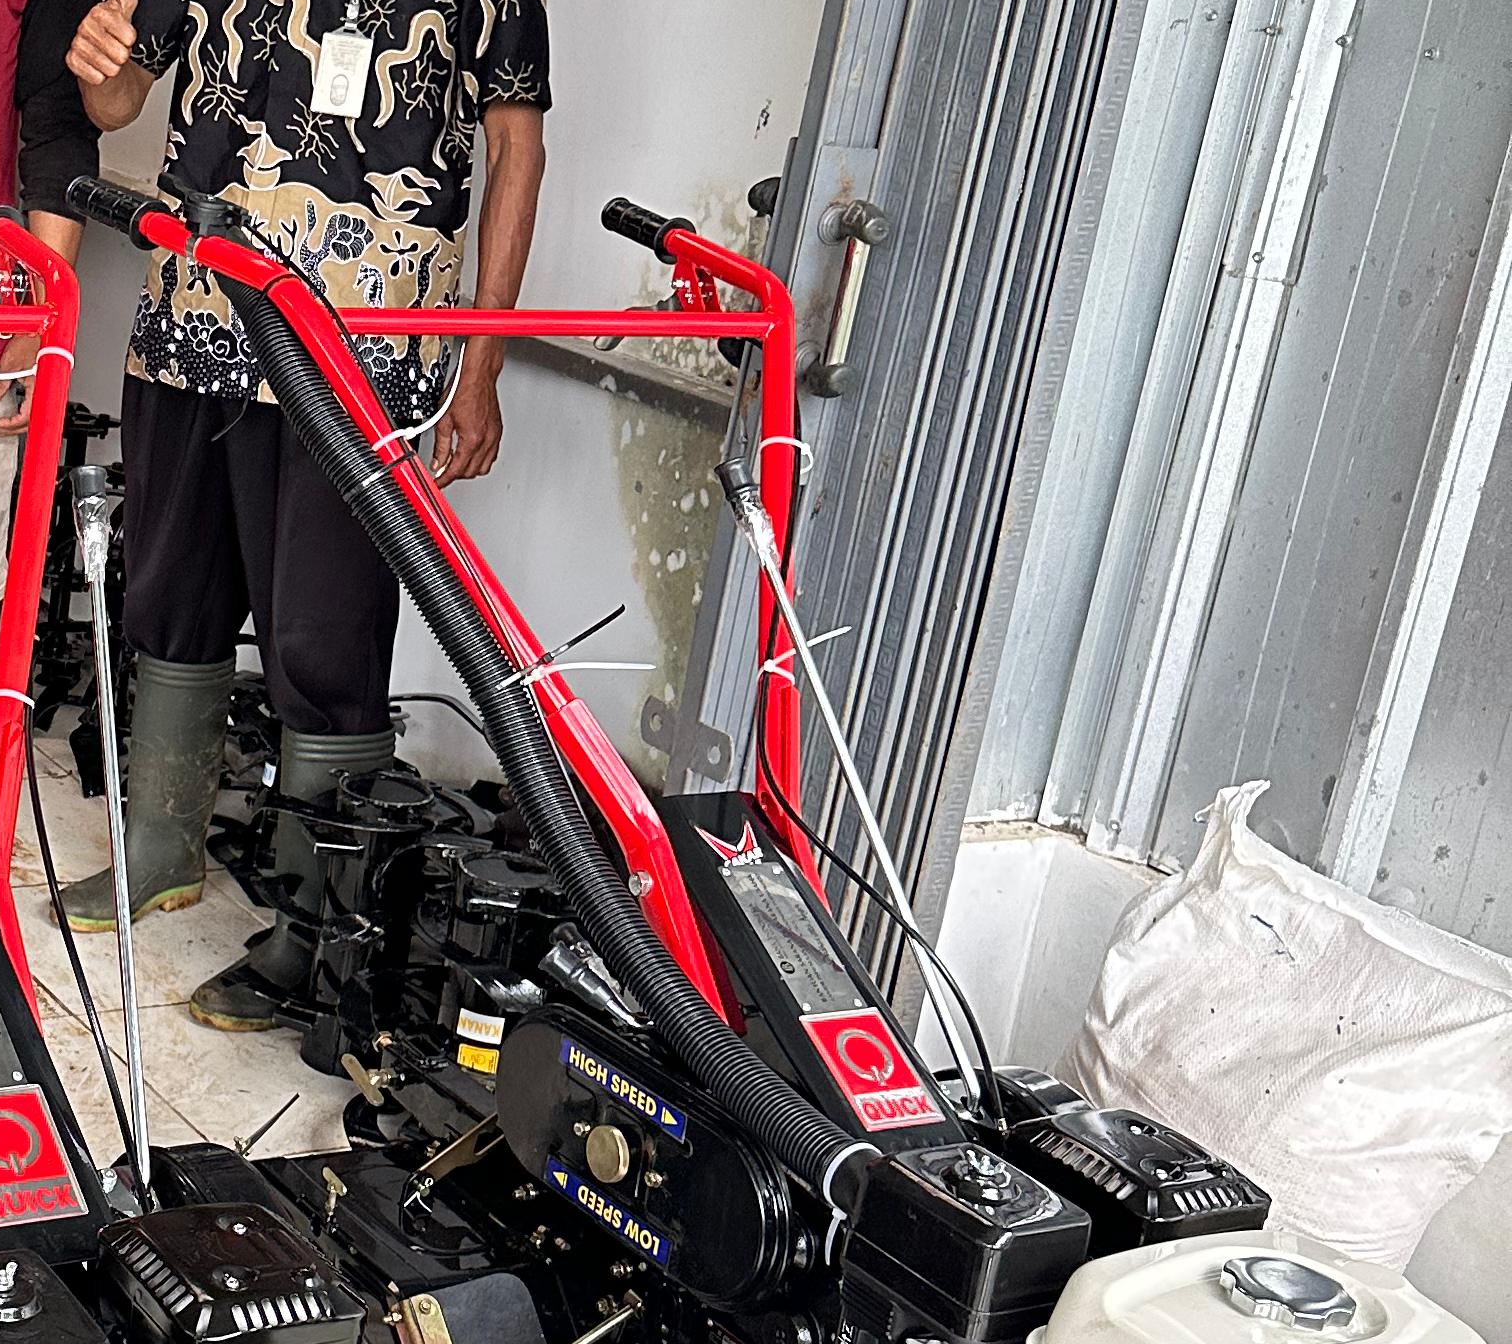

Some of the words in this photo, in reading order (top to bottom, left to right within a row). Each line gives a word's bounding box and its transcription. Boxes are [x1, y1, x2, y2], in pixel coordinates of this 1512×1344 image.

[459, 1016, 501, 1038] KANAN
[569, 1045, 608, 1086] HIGH
[610, 1073, 657, 1117] SPEED
[862, 1094, 936, 1122] QUICK
[577, 1184, 623, 1229] SPEED
[623, 1218, 661, 1256] LOW
